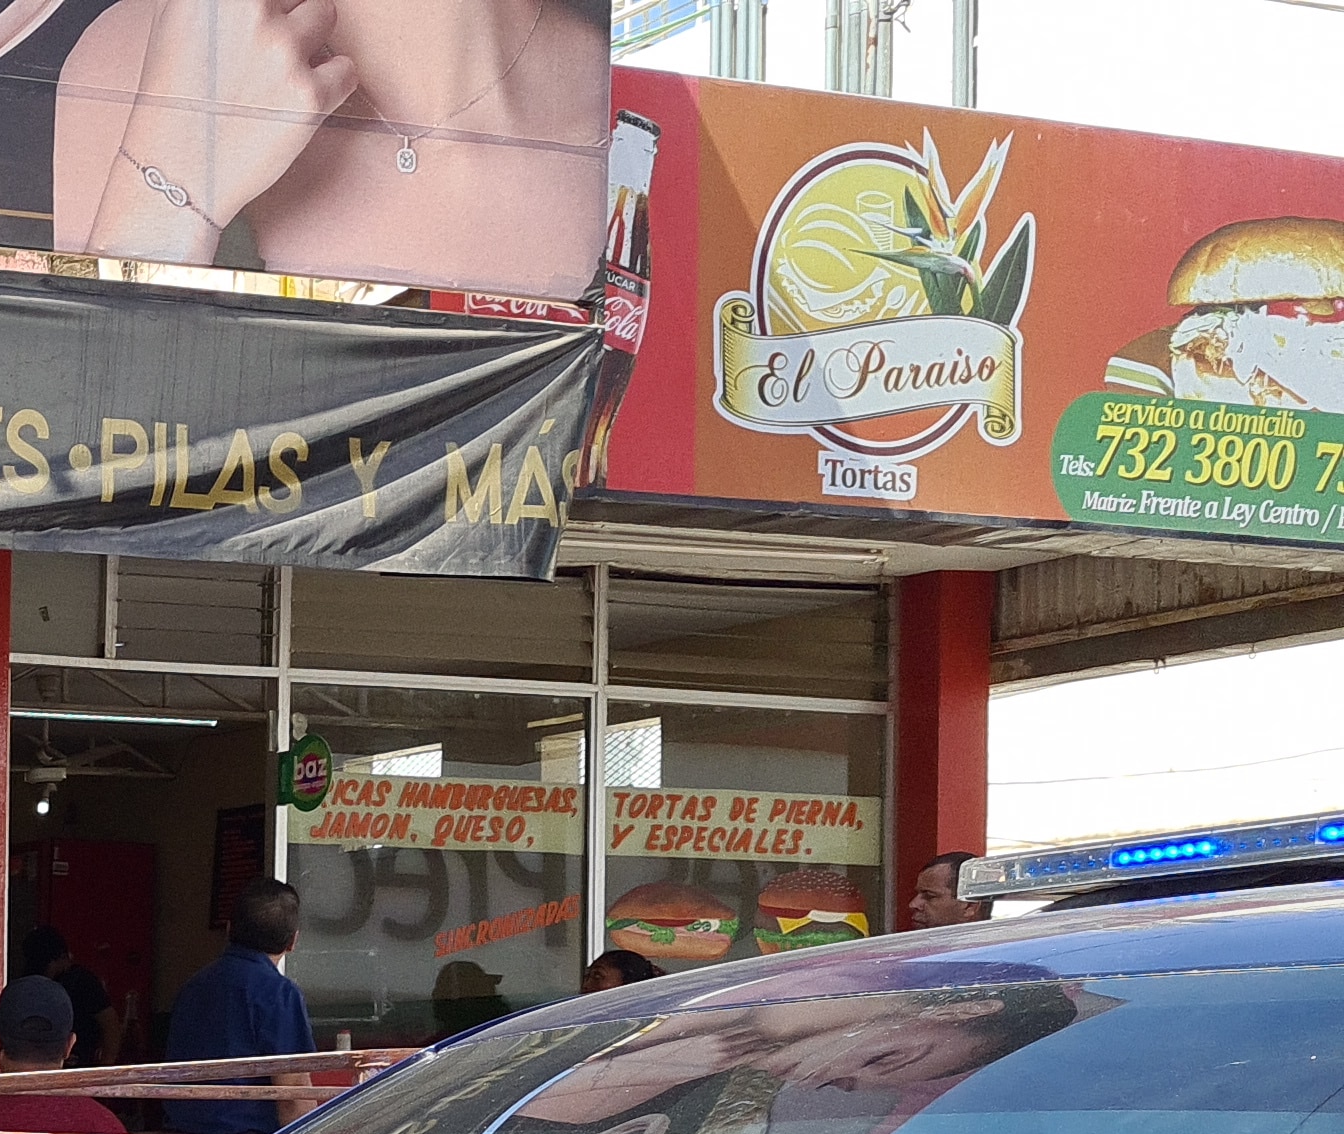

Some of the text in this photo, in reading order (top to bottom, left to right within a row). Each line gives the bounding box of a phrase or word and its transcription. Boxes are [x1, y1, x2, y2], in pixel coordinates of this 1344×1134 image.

[604, 270, 636, 292] ÚCAR
[733, 339, 1003, 408] El Paraiso
[1100, 400, 1306, 440] servicio a domicilio
[100, 417, 311, 514] PILAS
[349, 437, 392, 519] Y
[824, 458, 912, 493] Tortas
[1095, 424, 1178, 482] 732
[1185, 432, 1297, 491] 3800
[1139, 490, 1202, 519] Frente
[1204, 501, 1219, 519] a
[1220, 496, 1257, 529] Ley
[1258, 498, 1321, 527] Centro
[293, 756, 328, 781] baz
[321, 778, 393, 809] ICAS
[612, 791, 718, 822] TORTAS
[728, 796, 760, 824] DE
[768, 798, 864, 832] PIERNA,
[610, 823, 635, 851] Y
